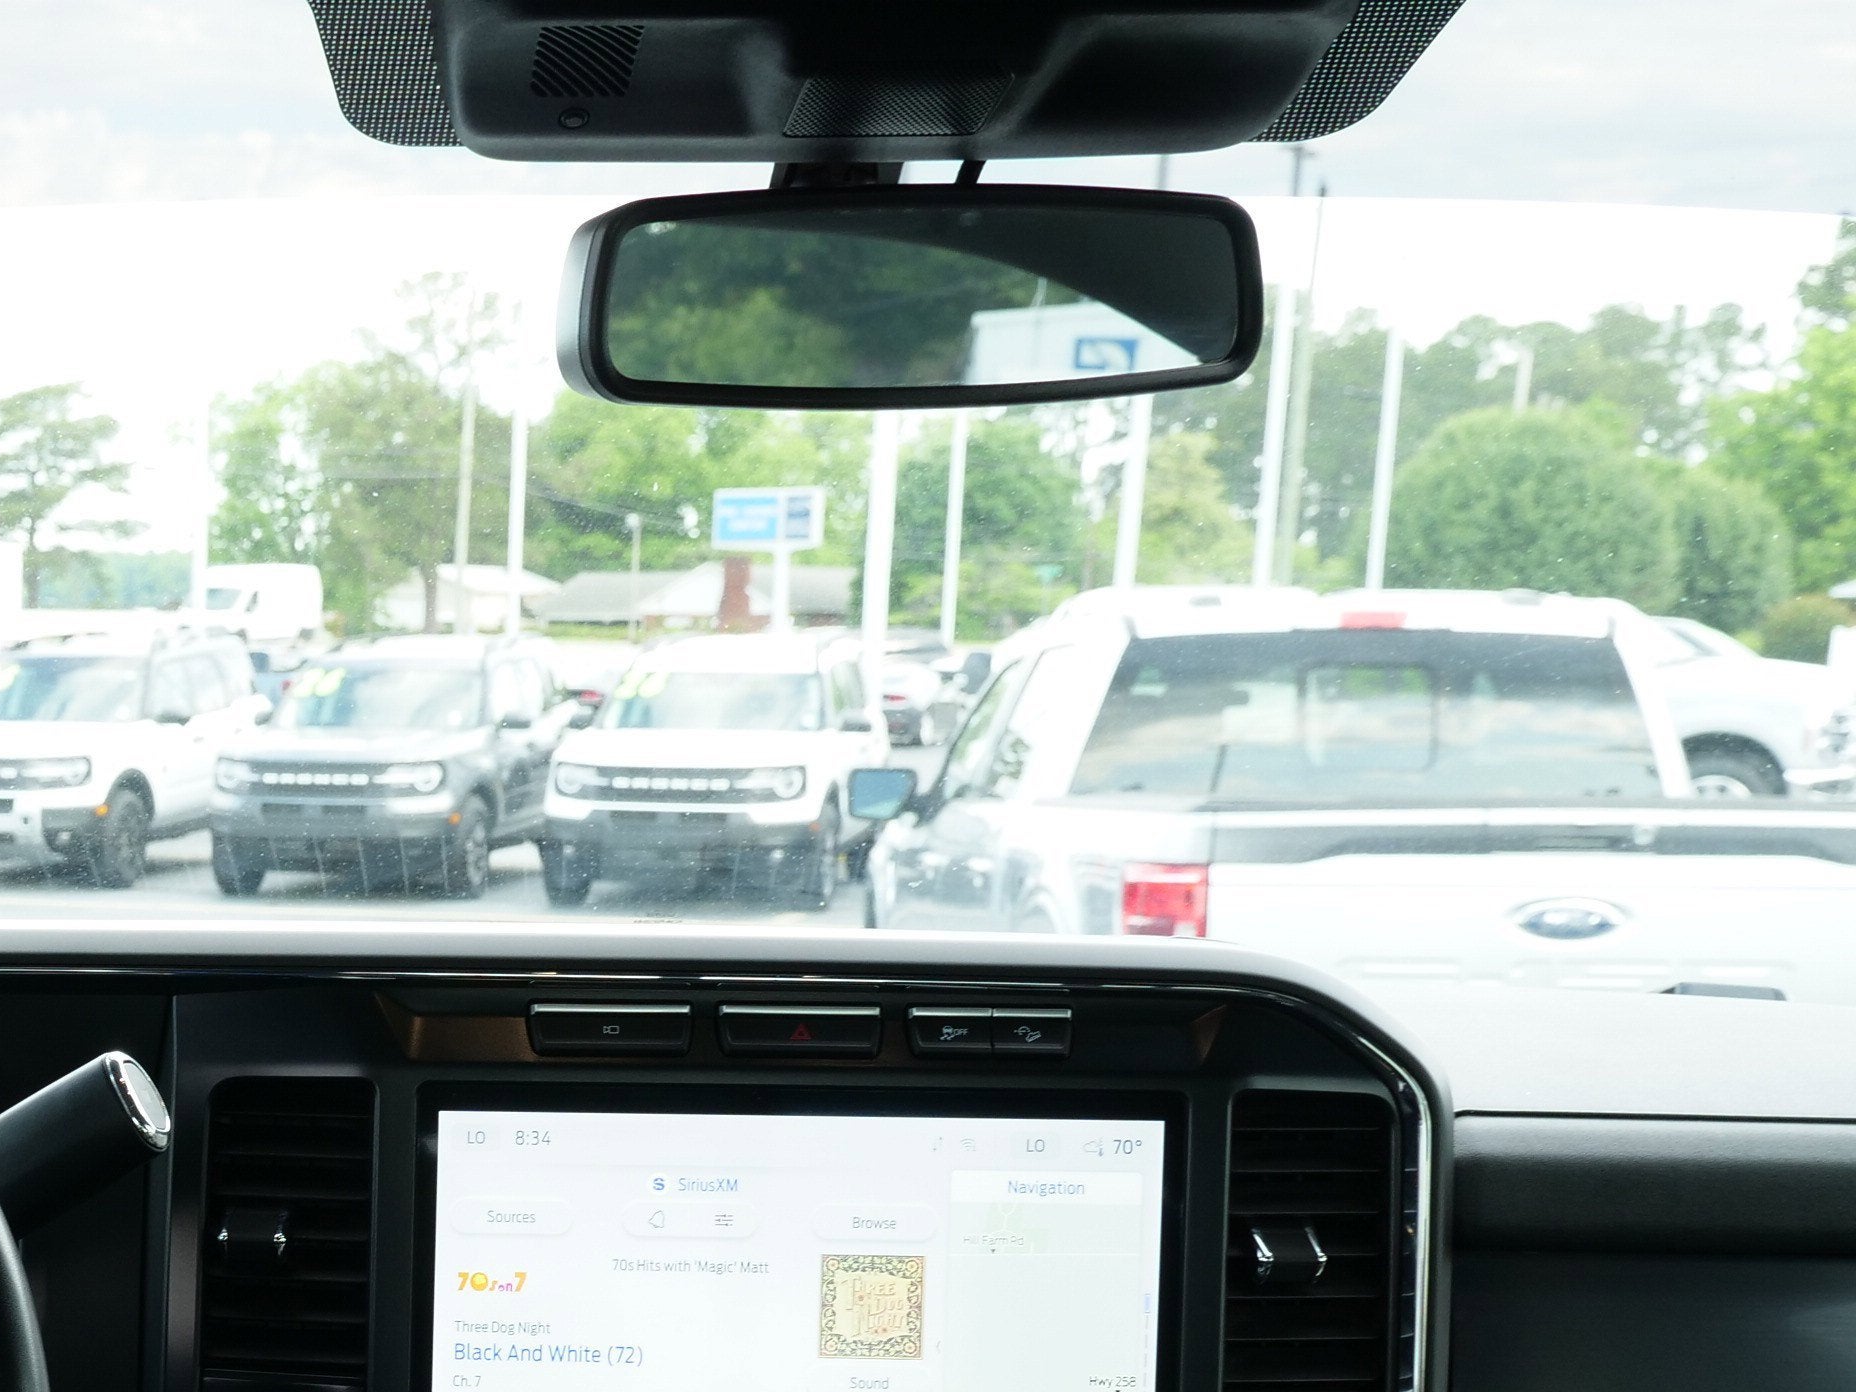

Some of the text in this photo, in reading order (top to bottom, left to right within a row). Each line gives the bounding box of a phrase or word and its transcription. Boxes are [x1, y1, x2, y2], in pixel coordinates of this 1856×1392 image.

[467, 1131, 486, 1145] LO
[515, 1130, 552, 1146] 8:34
[1026, 1139, 1046, 1153] LO
[1112, 1139, 1143, 1155] 70°
[678, 1177, 739, 1193] SiriusXM
[1008, 1180, 1085, 1197] Navigation
[487, 1209, 537, 1223] Sources
[852, 1216, 897, 1230] Browse
[612, 1258, 635, 1272] 70s
[636, 1258, 661, 1272] Hits
[663, 1259, 691, 1273] with
[739, 1260, 770, 1274] Matt
[454, 1320, 551, 1336] Three Dog Night
[454, 1343, 644, 1367] Black And White (72)
[452, 1374, 482, 1388] Ch. 7
[849, 1376, 889, 1390] Sound
[1089, 1376, 1137, 1389] Hwy 258
